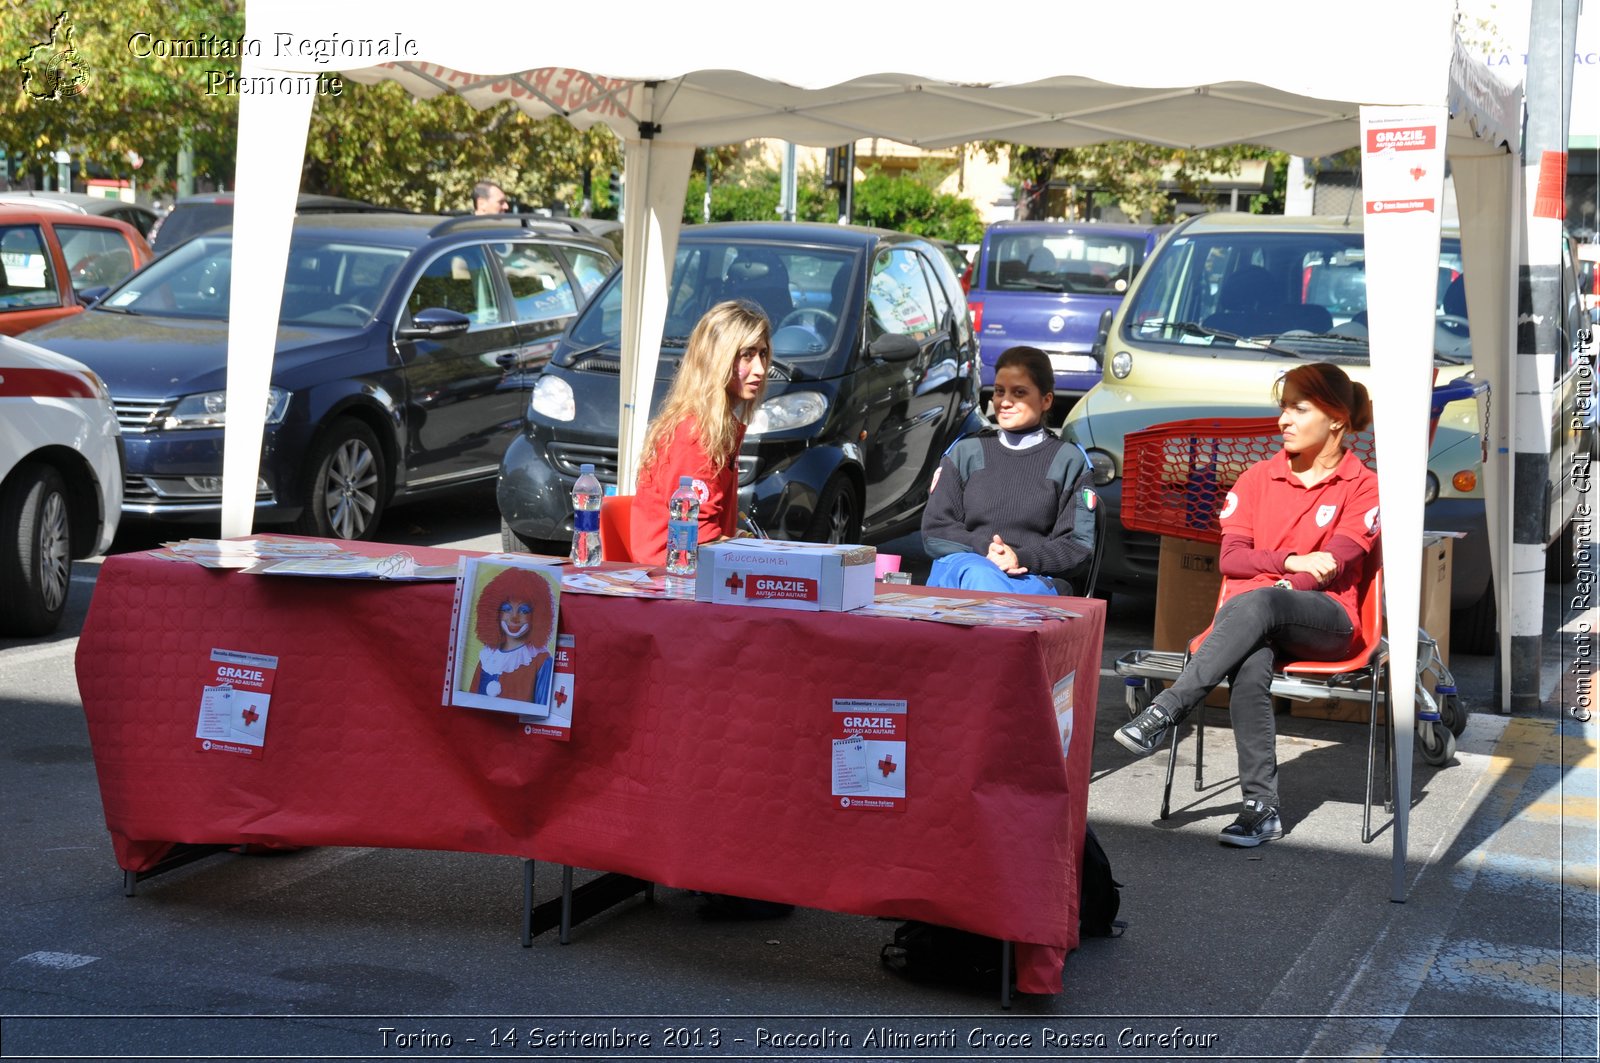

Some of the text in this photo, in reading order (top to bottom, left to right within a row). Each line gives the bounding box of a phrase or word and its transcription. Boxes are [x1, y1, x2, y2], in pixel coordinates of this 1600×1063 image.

[1487, 55, 1510, 66] LA
[1375, 130, 1427, 142] GRAZIE.
[756, 579, 808, 592] GRAZIE.
[755, 590, 777, 598] AIUTACI
[216, 676, 235, 684] AIUTACI
[217, 666, 265, 682] GRAZIE.
[843, 716, 896, 728] GRAZIE.
